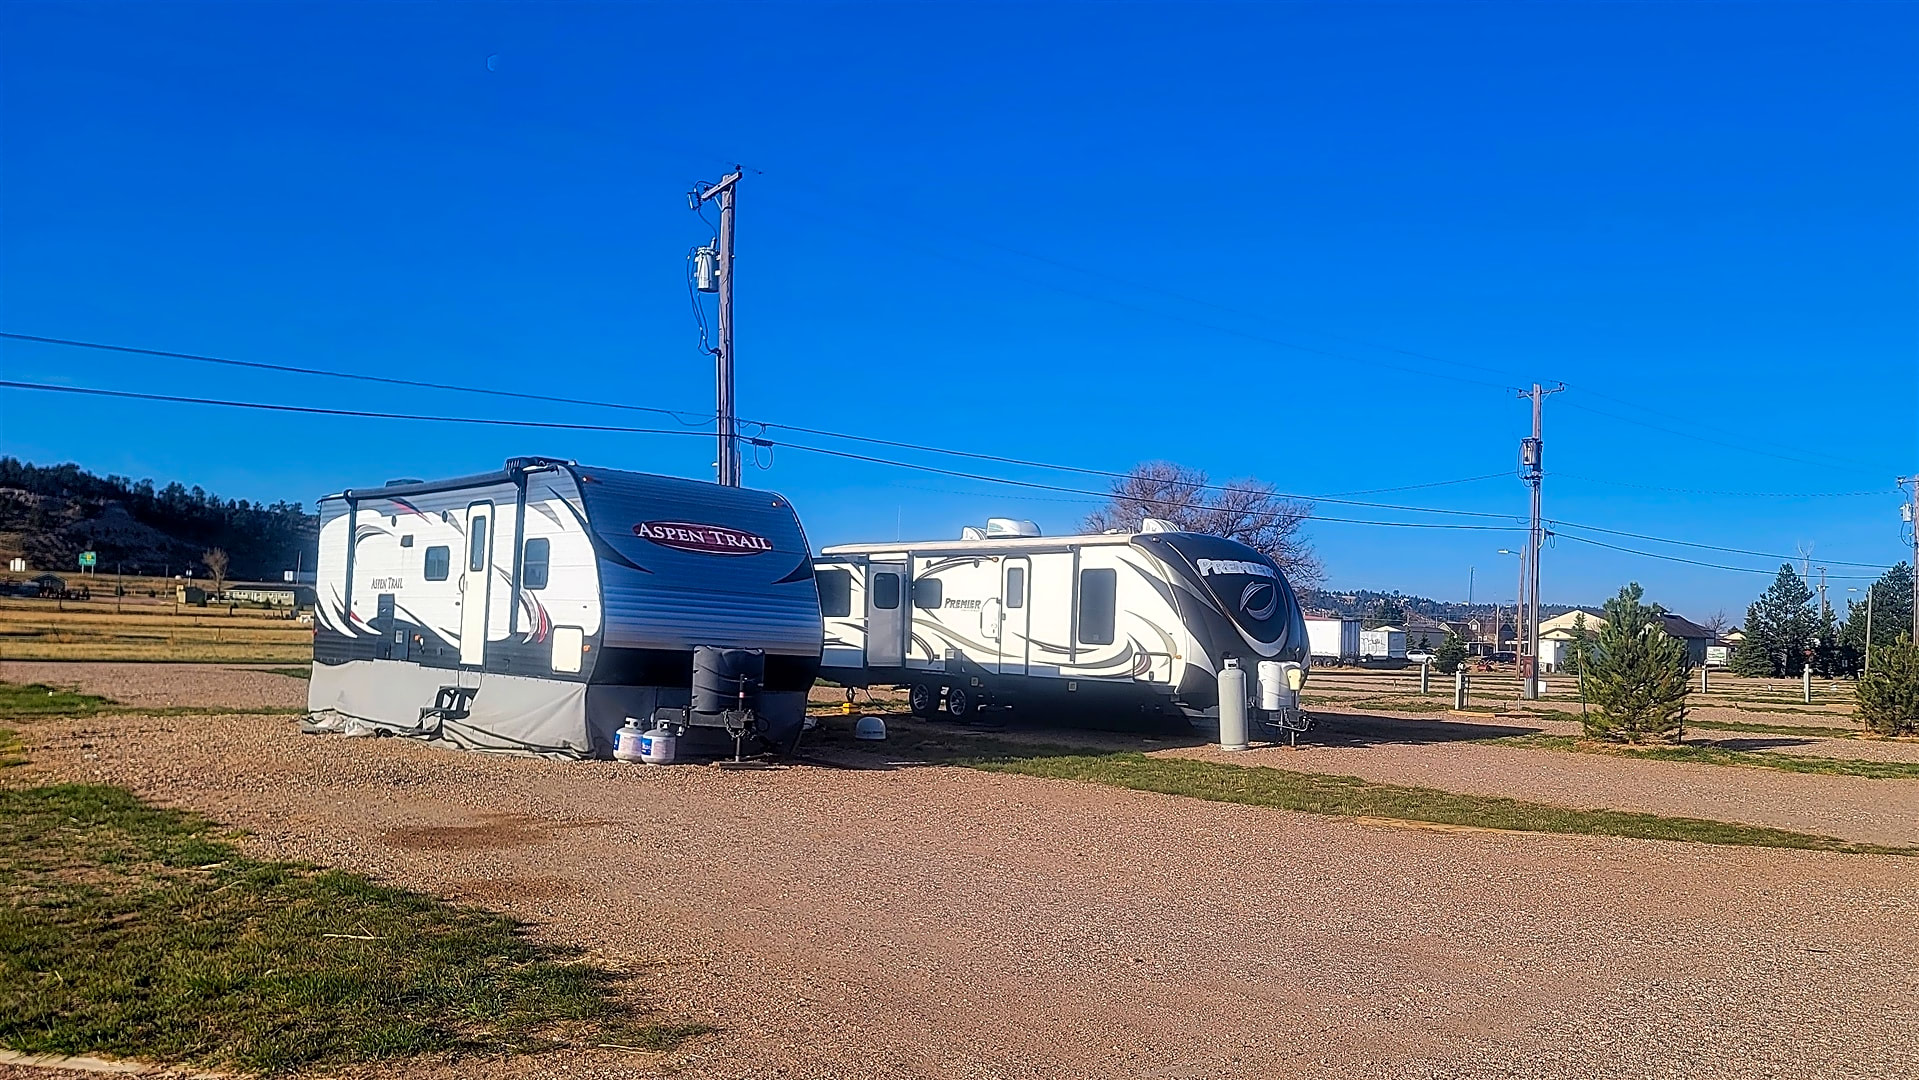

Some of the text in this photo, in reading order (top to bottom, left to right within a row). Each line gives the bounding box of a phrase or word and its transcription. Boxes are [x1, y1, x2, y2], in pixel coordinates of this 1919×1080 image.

[637, 521, 772, 551] ASPEN TRAIL
[1196, 558, 1277, 580] PREMIER
[370, 577, 403, 590] ASPEN TRAIL
[944, 597, 982, 610] PREMIER
